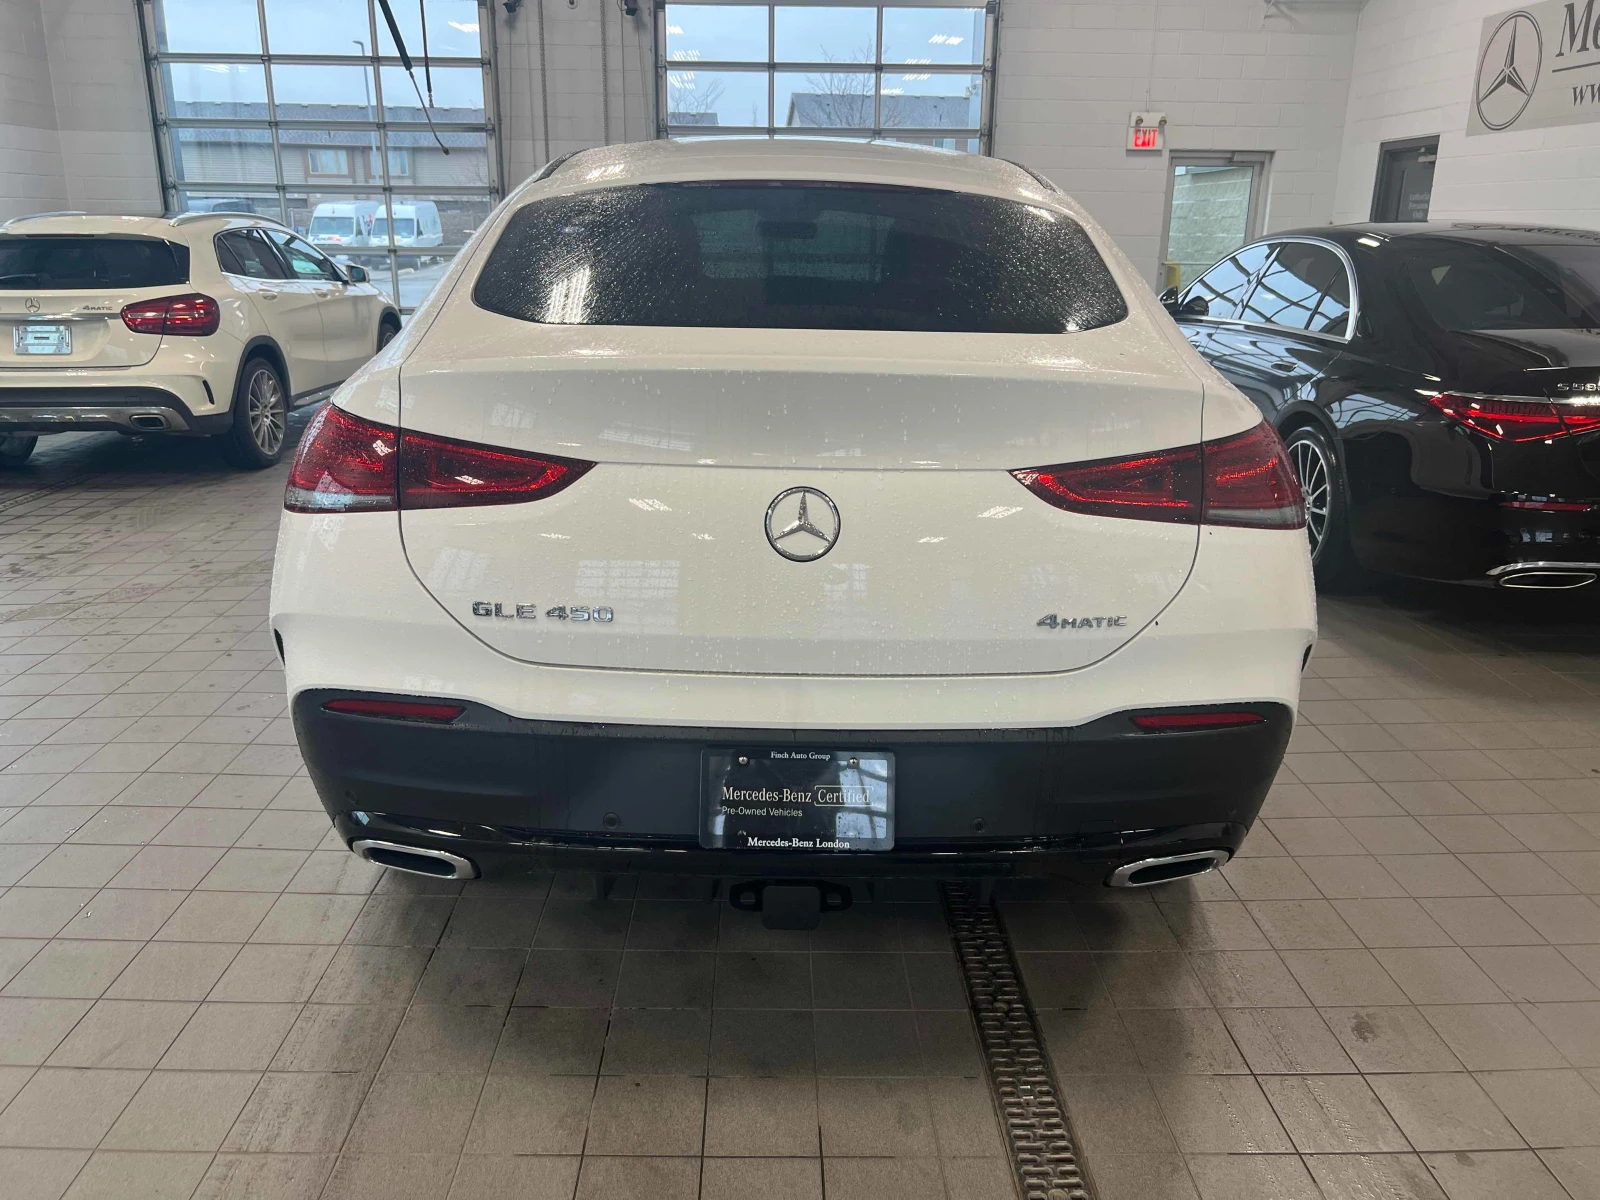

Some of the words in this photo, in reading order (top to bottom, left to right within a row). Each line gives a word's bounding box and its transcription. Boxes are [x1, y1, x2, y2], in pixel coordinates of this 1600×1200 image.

[1134, 128, 1158, 148] EXIT
[1557, 382, 1570, 391] S
[1572, 382, 1600, 391] 58
[472, 600, 537, 619] GLE
[545, 604, 614, 623] 450
[1036, 613, 1127, 629] 4MATIC
[770, 751, 789, 759] Finch
[790, 752, 807, 760] Auto
[809, 752, 831, 761] Group
[722, 786, 812, 803] Mercedes-Benz
[818, 788, 870, 803] Certified
[722, 806, 767, 816] Pre-Owned
[769, 807, 803, 817] Vehicles
[747, 837, 814, 848] Mercedes-Benz
[816, 838, 850, 849] London
